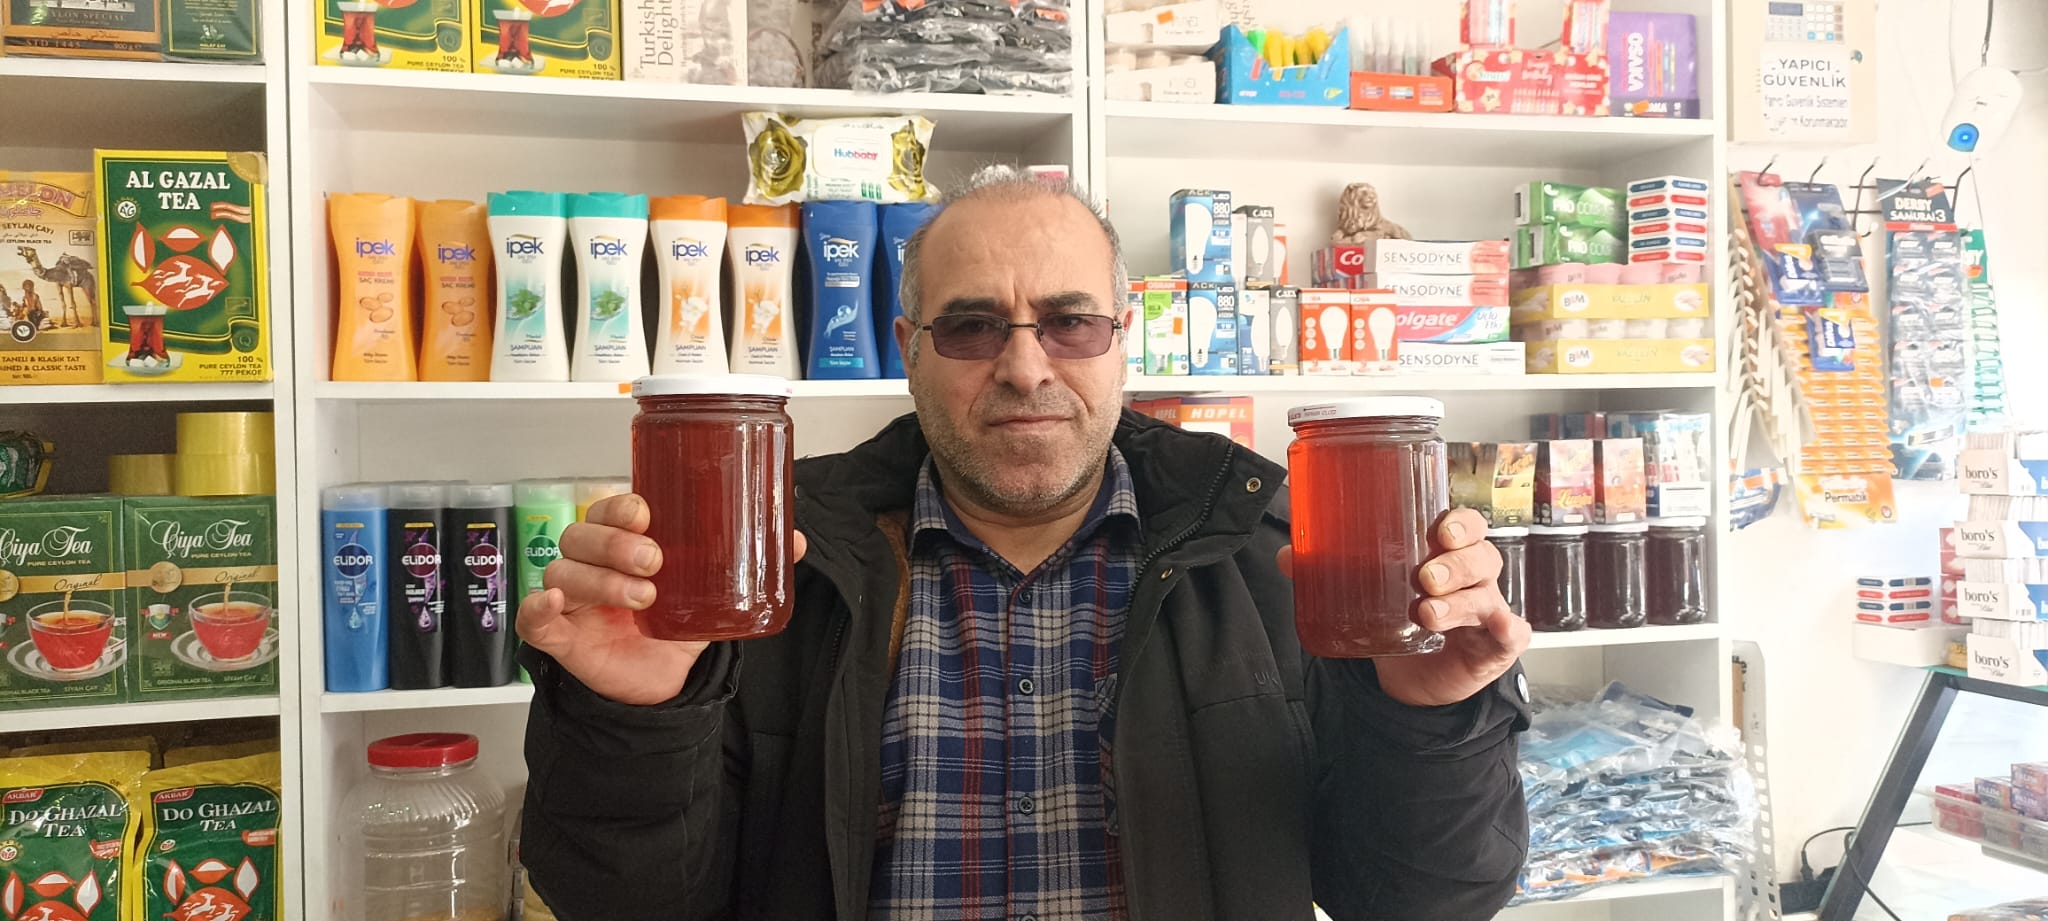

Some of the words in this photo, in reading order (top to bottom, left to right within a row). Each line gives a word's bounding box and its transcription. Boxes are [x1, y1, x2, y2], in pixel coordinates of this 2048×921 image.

[1627, 32, 1644, 92] OSAKA
[1779, 58, 1831, 71] YAPICI
[126, 170, 154, 188] AL
[159, 171, 230, 189] GAZAL
[158, 192, 201, 210] TEA
[1213, 203, 1231, 214] 880
[1895, 197, 1932, 210] DERBY
[1890, 210, 1935, 221] SAMURAI
[1935, 209, 1946, 222] 3
[356, 237, 395, 258] ipek
[438, 243, 476, 263] ipek
[506, 237, 544, 258] ipek
[590, 238, 628, 259] ipek
[672, 240, 708, 261] ipek
[745, 246, 780, 266] ipek
[823, 241, 860, 262] ipek
[1384, 252, 1462, 263] SENSODYNE
[1217, 295, 1234, 307] 880
[1399, 354, 1479, 365] SENSODYNE
[1965, 465, 1998, 480] boro's
[42, 525, 93, 558] Tea
[150, 520, 205, 559] Çiya
[205, 519, 253, 550] Tea
[1960, 528, 1995, 541] boro's
[54, 574, 103, 591] Original
[215, 566, 260, 583] Original
[1964, 587, 1998, 603] boro's
[1974, 650, 2009, 668] boro's
[159, 790, 188, 799] AKBAR
[44, 804, 122, 821] GHAZAL
[162, 808, 194, 821] DO
[198, 800, 275, 817] GHAZAL
[43, 823, 85, 837] TEA
[200, 819, 237, 831] TEA
